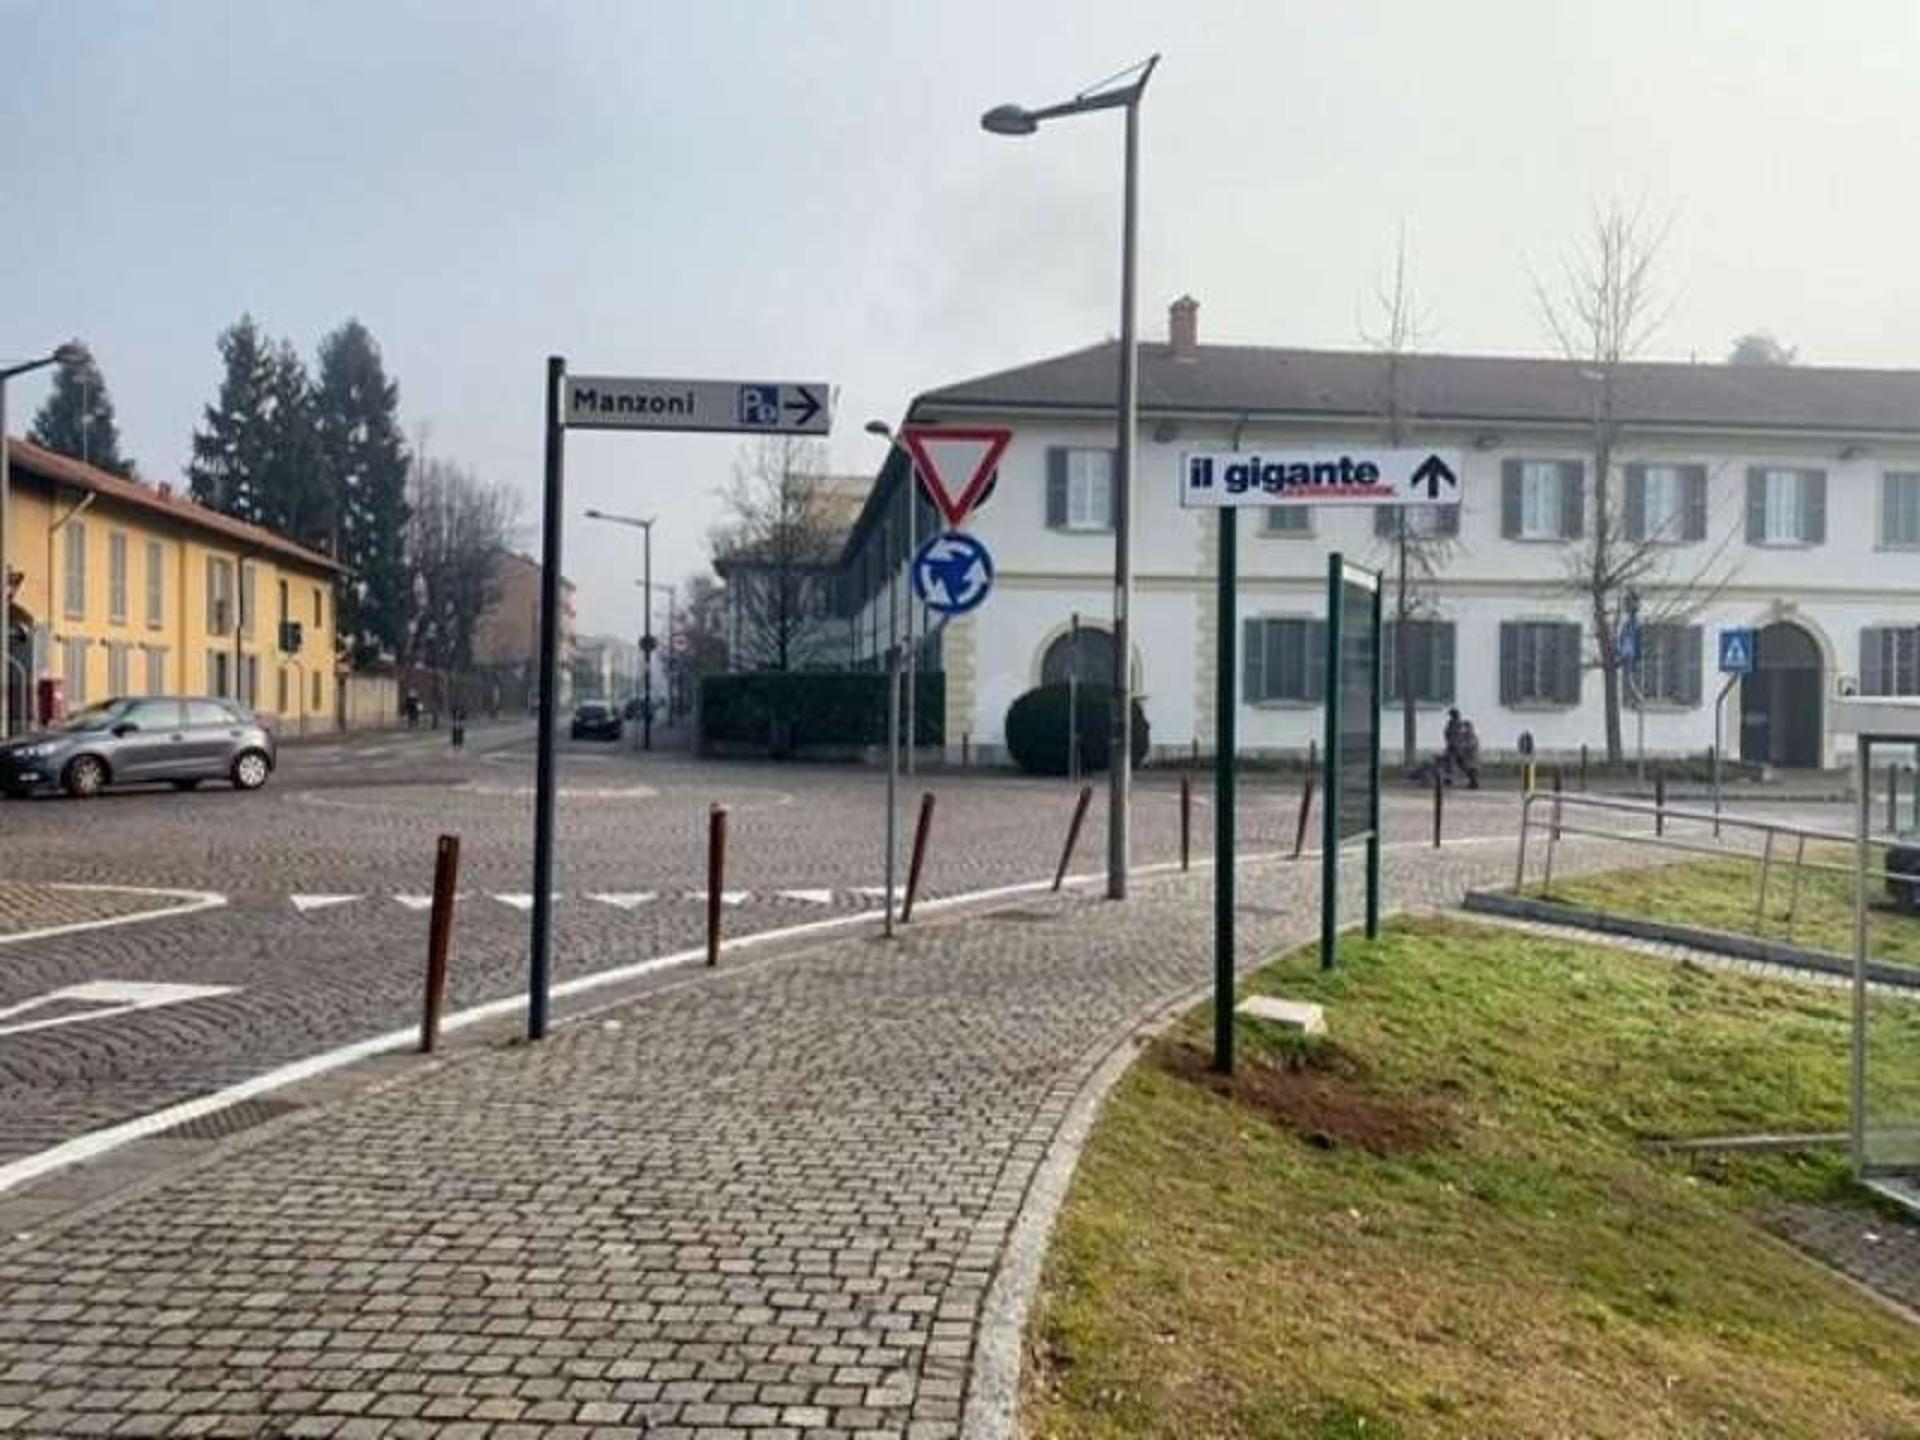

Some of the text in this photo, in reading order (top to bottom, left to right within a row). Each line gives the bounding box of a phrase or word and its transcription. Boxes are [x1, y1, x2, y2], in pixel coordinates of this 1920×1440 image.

[573, 388, 695, 414] Manzoni
[1190, 457, 1214, 487] il
[1224, 456, 1380, 493] gigante
